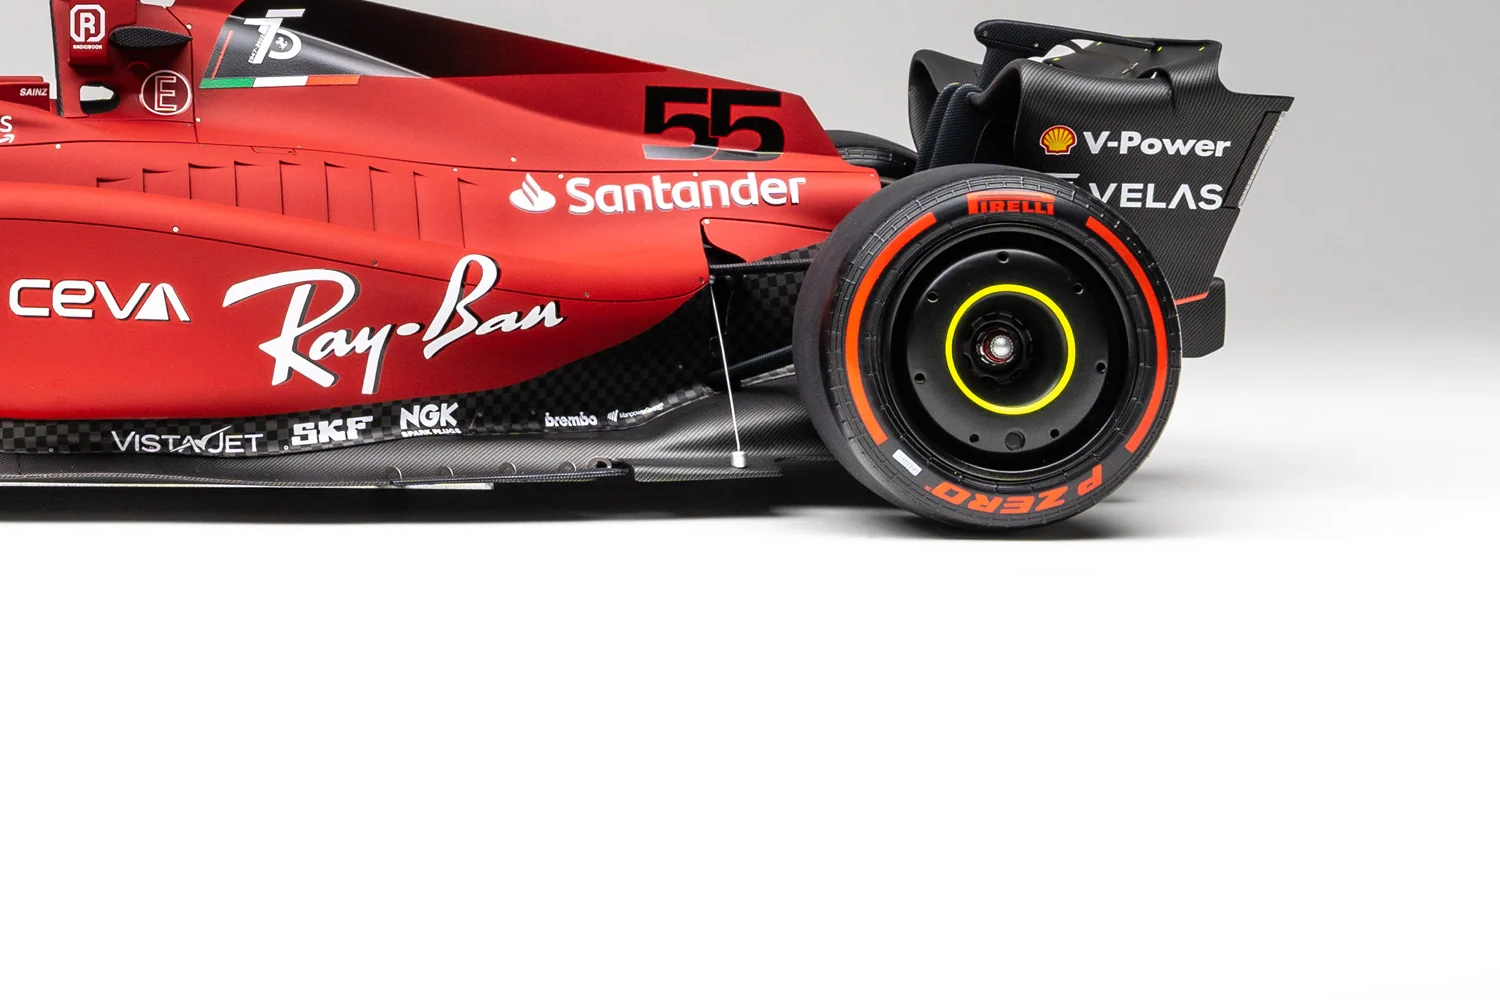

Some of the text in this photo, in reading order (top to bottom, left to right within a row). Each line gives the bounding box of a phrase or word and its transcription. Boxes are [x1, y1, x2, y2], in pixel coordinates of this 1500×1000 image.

[19, 87, 48, 97] SAINZ
[642, 85, 785, 162] 55
[1082, 131, 1231, 157] V-Power
[565, 172, 807, 215] Santander
[966, 188, 1055, 215] PIRELLI
[1088, 182, 1223, 210] VELAS
[222, 253, 567, 395] Ray-Ban
[401, 402, 460, 430] NGK
[545, 412, 598, 427] brembo
[291, 415, 374, 446] SKF
[401, 427, 462, 438] SPARK PLUGS
[930, 463, 1103, 515] P ZERO
